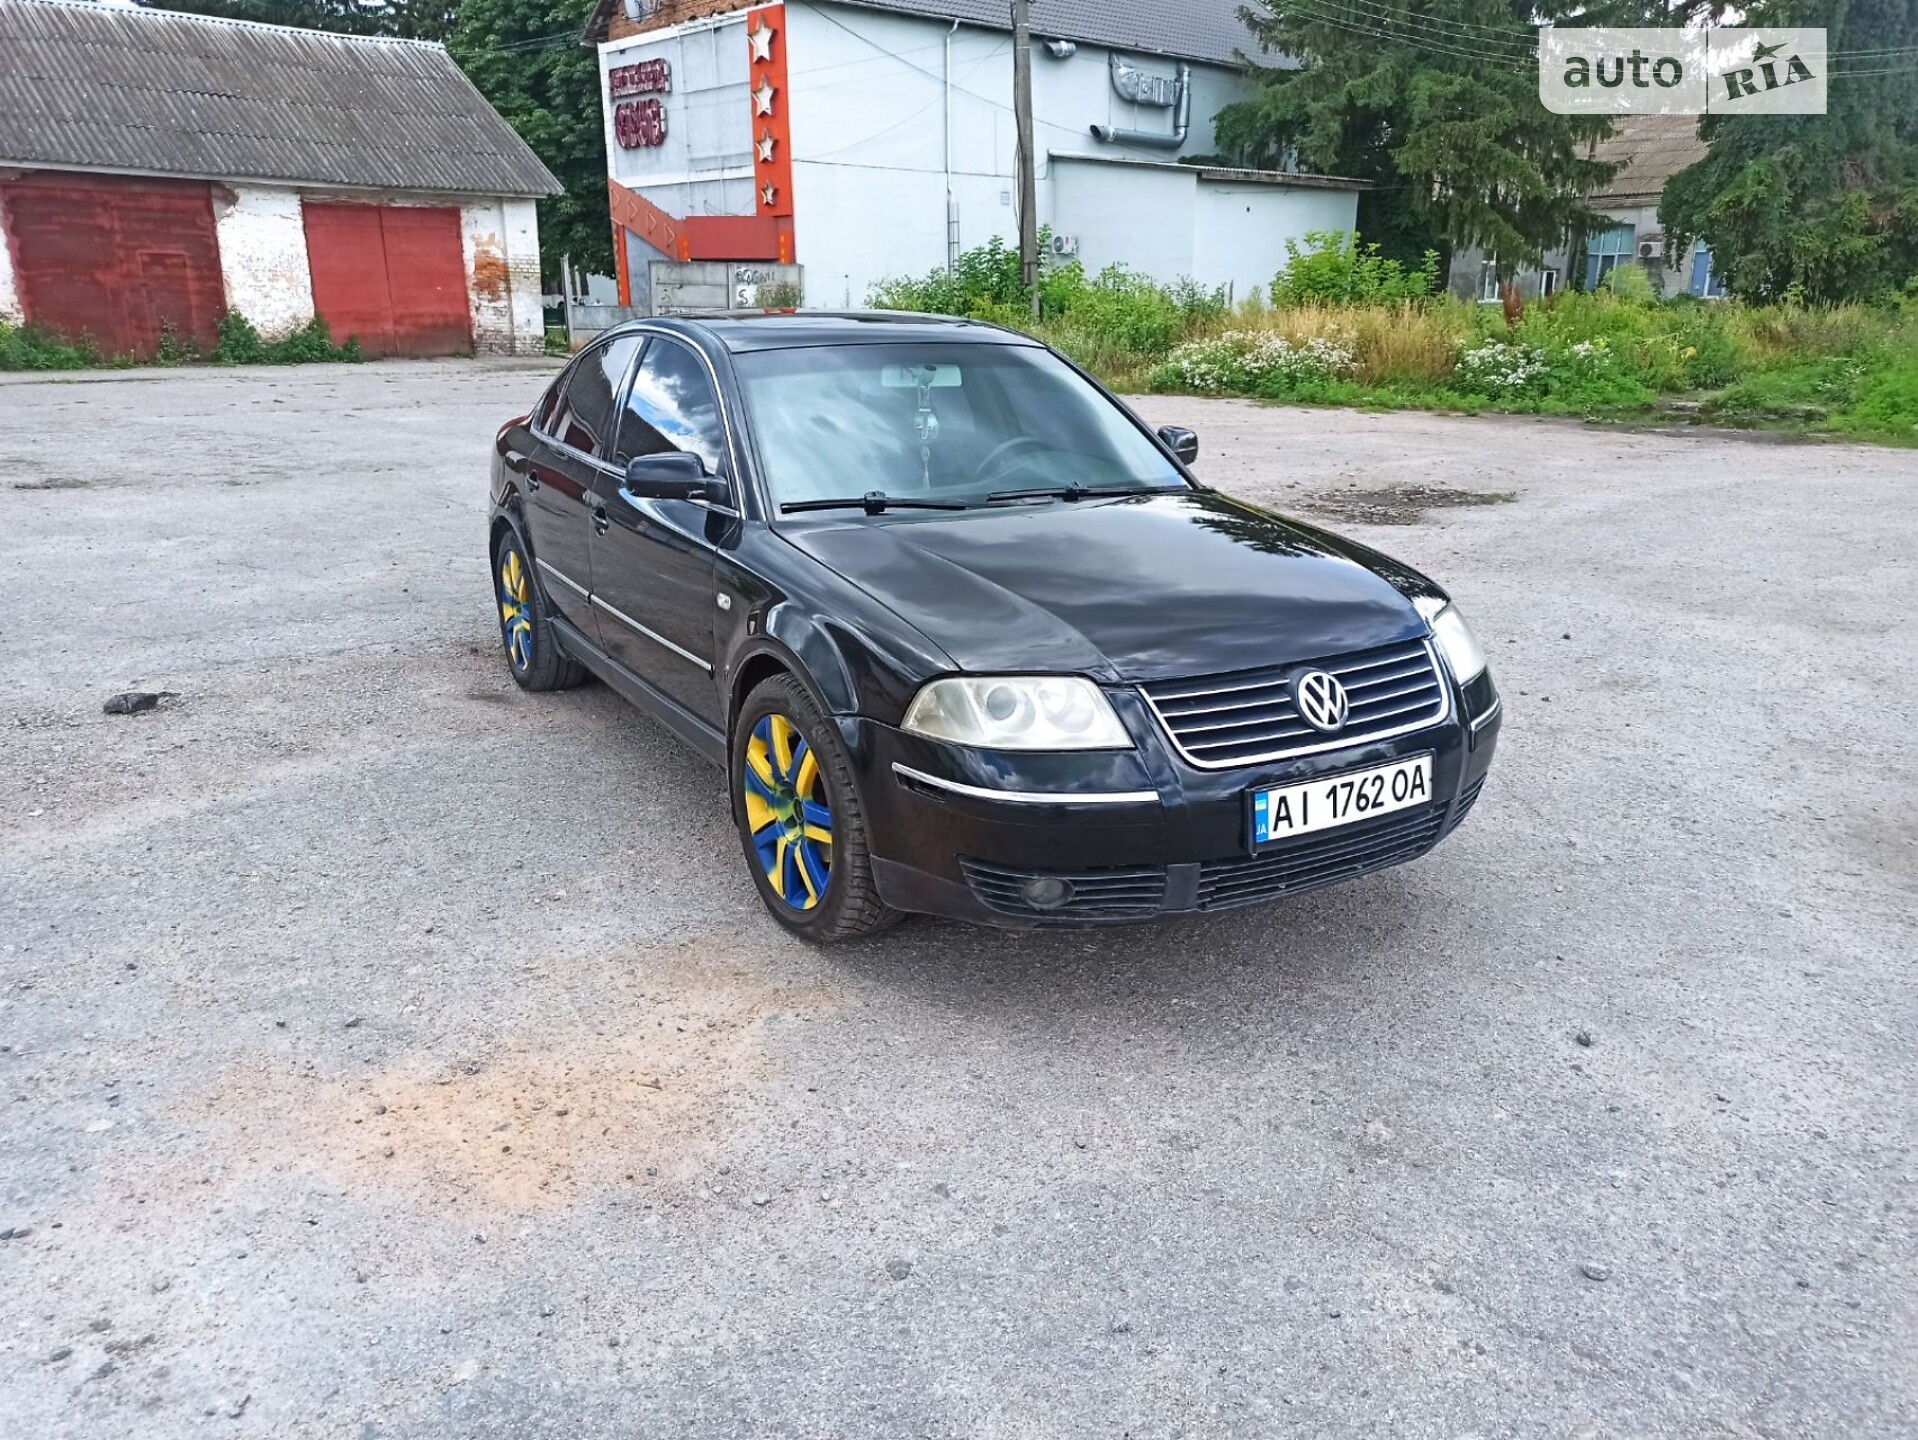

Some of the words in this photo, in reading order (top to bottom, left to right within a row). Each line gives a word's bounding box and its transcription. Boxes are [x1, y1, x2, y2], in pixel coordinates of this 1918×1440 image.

[1273, 791, 1308, 832] AI
[1325, 774, 1385, 820] 1762
[1391, 764, 1426, 802] OA
